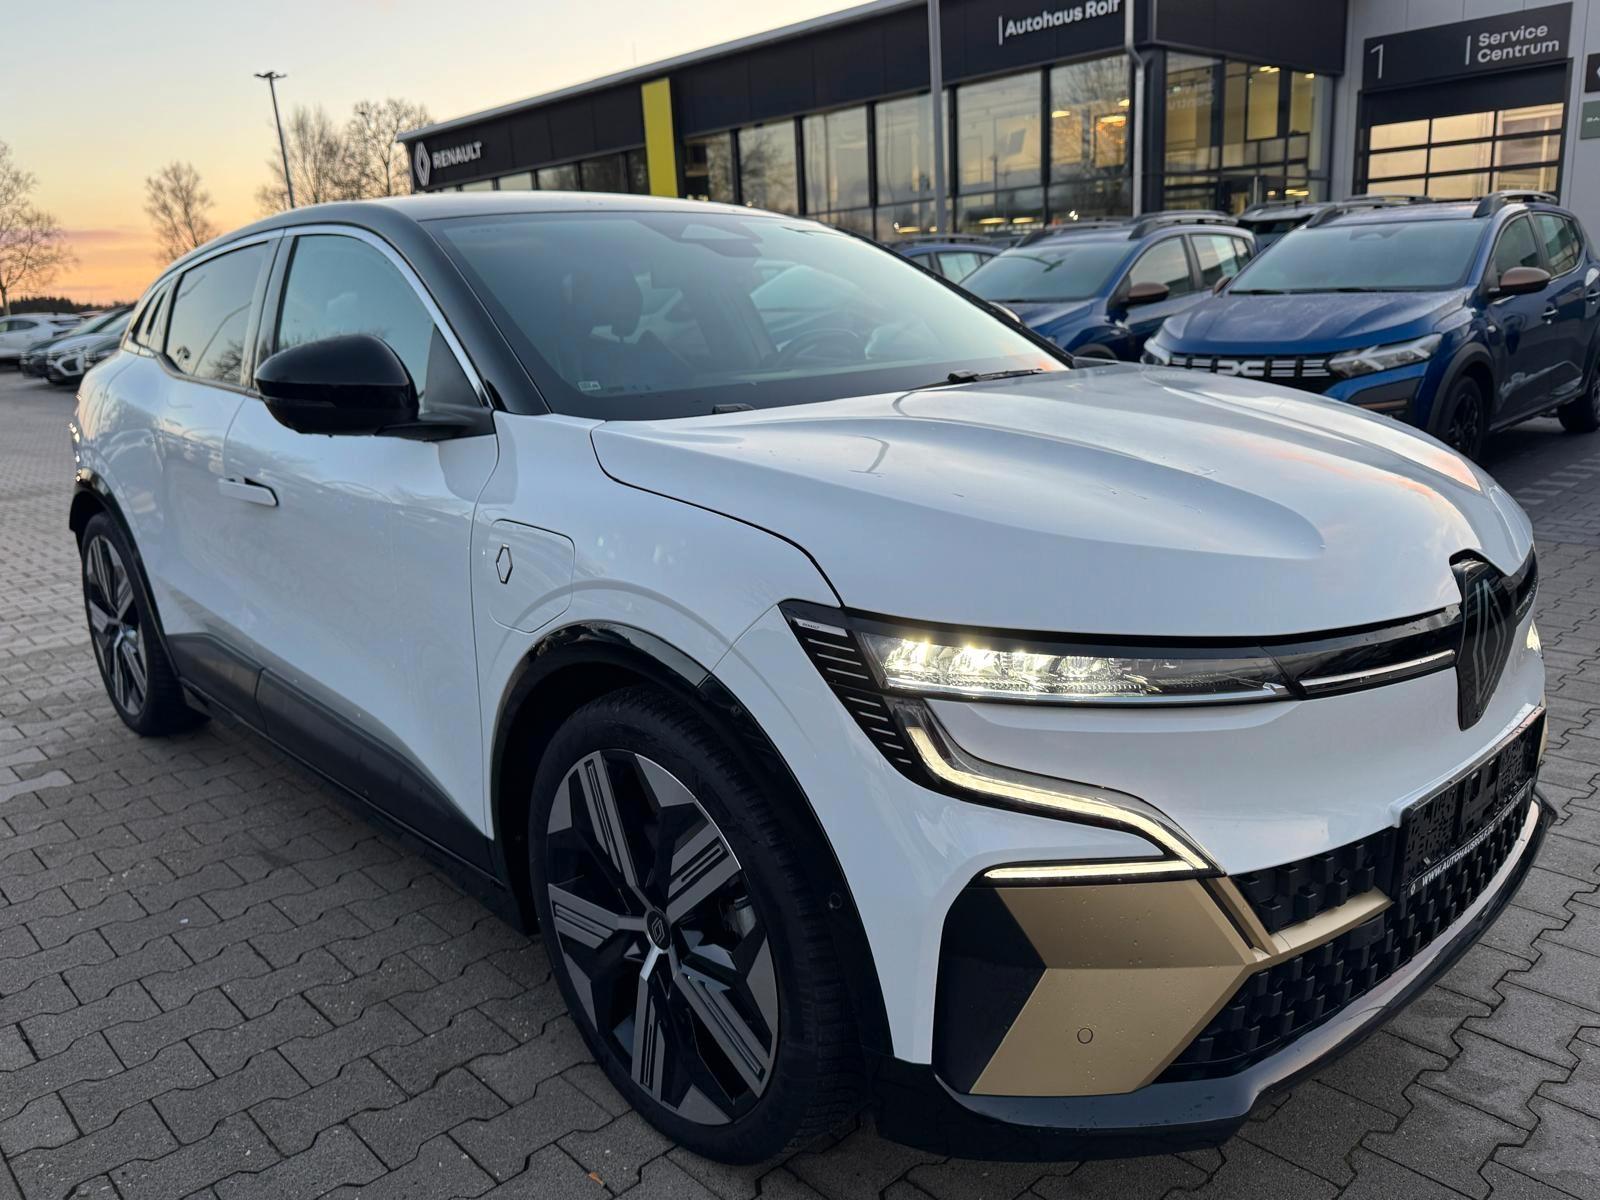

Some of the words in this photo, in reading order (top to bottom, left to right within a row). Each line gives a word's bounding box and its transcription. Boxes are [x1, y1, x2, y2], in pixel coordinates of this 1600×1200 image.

[1005, 6, 1083, 37] Autohaus
[1478, 25, 1548, 47] Service
[1477, 40, 1560, 63] Centrum
[432, 141, 482, 169] RENAULT
